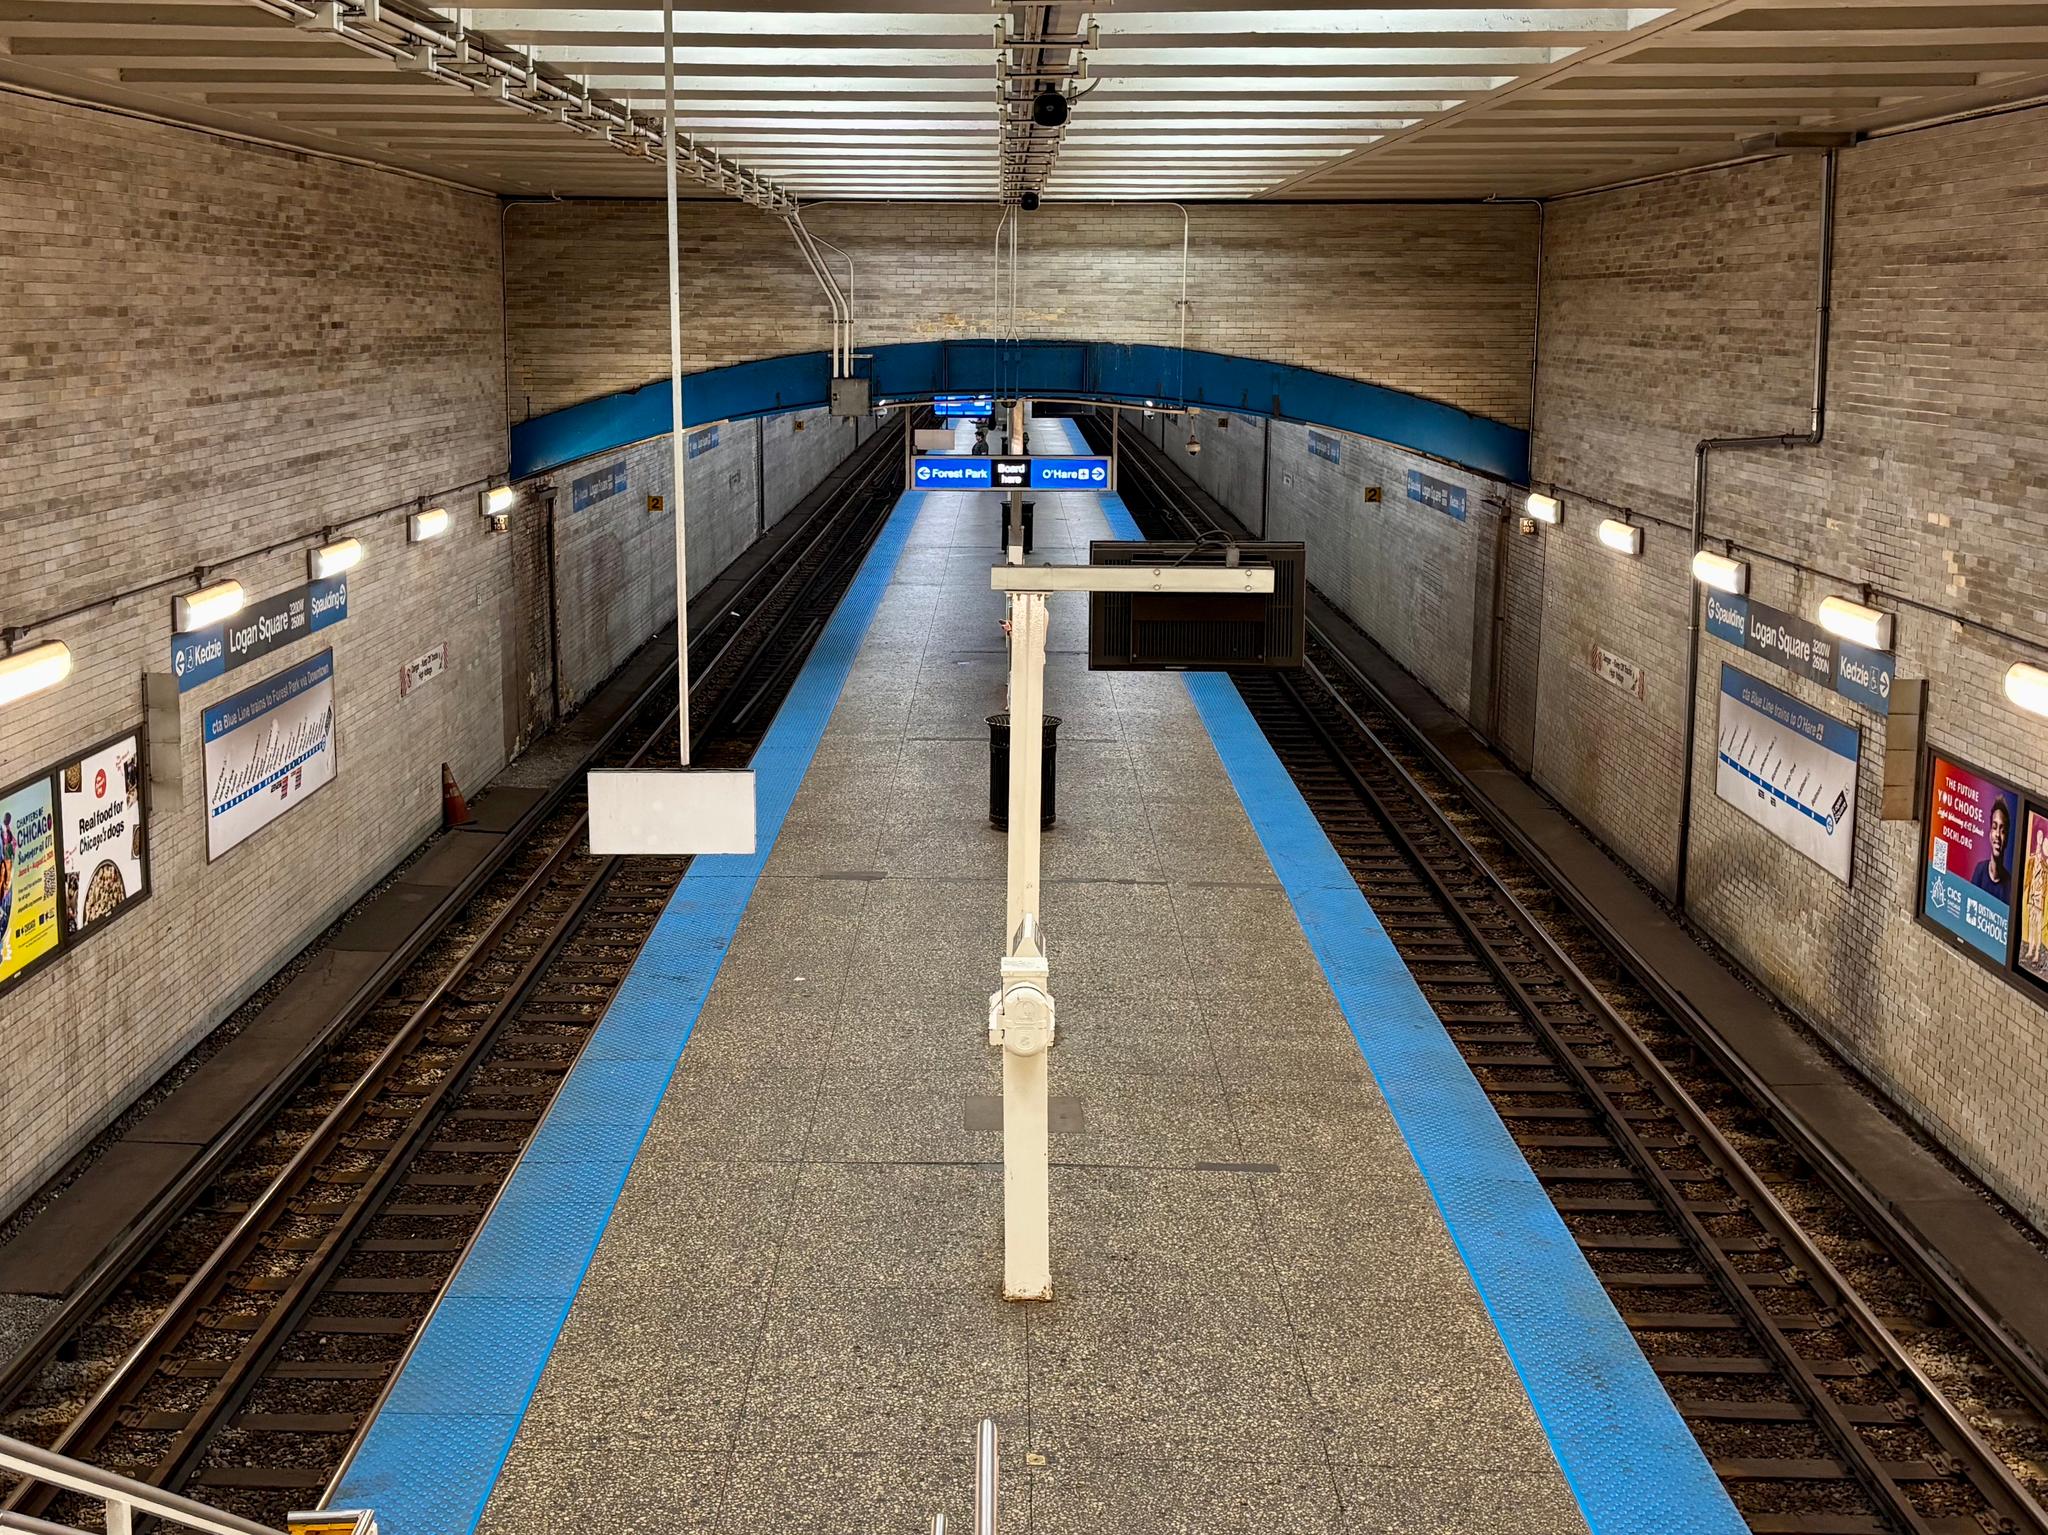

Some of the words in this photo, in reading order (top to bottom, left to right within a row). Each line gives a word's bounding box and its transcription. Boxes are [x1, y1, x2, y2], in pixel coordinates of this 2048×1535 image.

[932, 468, 963, 479] Forest
[965, 468, 988, 479] Park
[997, 463, 1026, 474] Board
[1001, 474, 1023, 485] here
[1042, 469, 1078, 480] O'Hare
[651, 497, 660, 509] 2
[1368, 488, 1378, 502] 2
[311, 591, 340, 618] Spaulding
[1715, 602, 1745, 634] Spaulding
[229, 628, 258, 655] Logan
[259, 611, 289, 643] Square
[1750, 614, 1777, 649] Logan
[1777, 625, 1811, 662] Square
[194, 639, 222, 666] Kedzie
[1840, 656, 1869, 687] Kedzie
[212, 719, 223, 734] cta
[223, 712, 238, 729] Blue
[237, 706, 250, 721] Line
[250, 698, 266, 715] trains
[266, 694, 272, 706] to
[272, 684, 288, 703] Forest
[288, 678, 300, 694] Park
[1750, 690, 1762, 707] Blue
[1762, 697, 1774, 714] Line
[1774, 703, 1790, 723] trains
[1790, 712, 1796, 726] to
[1945, 776, 1956, 791] THE
[1957, 782, 1979, 802] FUTURE
[16, 810, 38, 829] CHAPTERS
[79, 811, 97, 835] Real
[96, 803, 114, 824] food
[113, 800, 124, 816] for
[1937, 789, 1953, 807] YOU
[1954, 797, 1985, 823] CHOOSE.
[17, 813, 52, 848] CHICAGO
[79, 826, 107, 855] Chicago's
[107, 820, 125, 840] dogs
[1947, 886, 1962, 903] CICS
[1978, 904, 2009, 930] DISTINCTIVE
[1977, 916, 2008, 946] SCHOOLS
